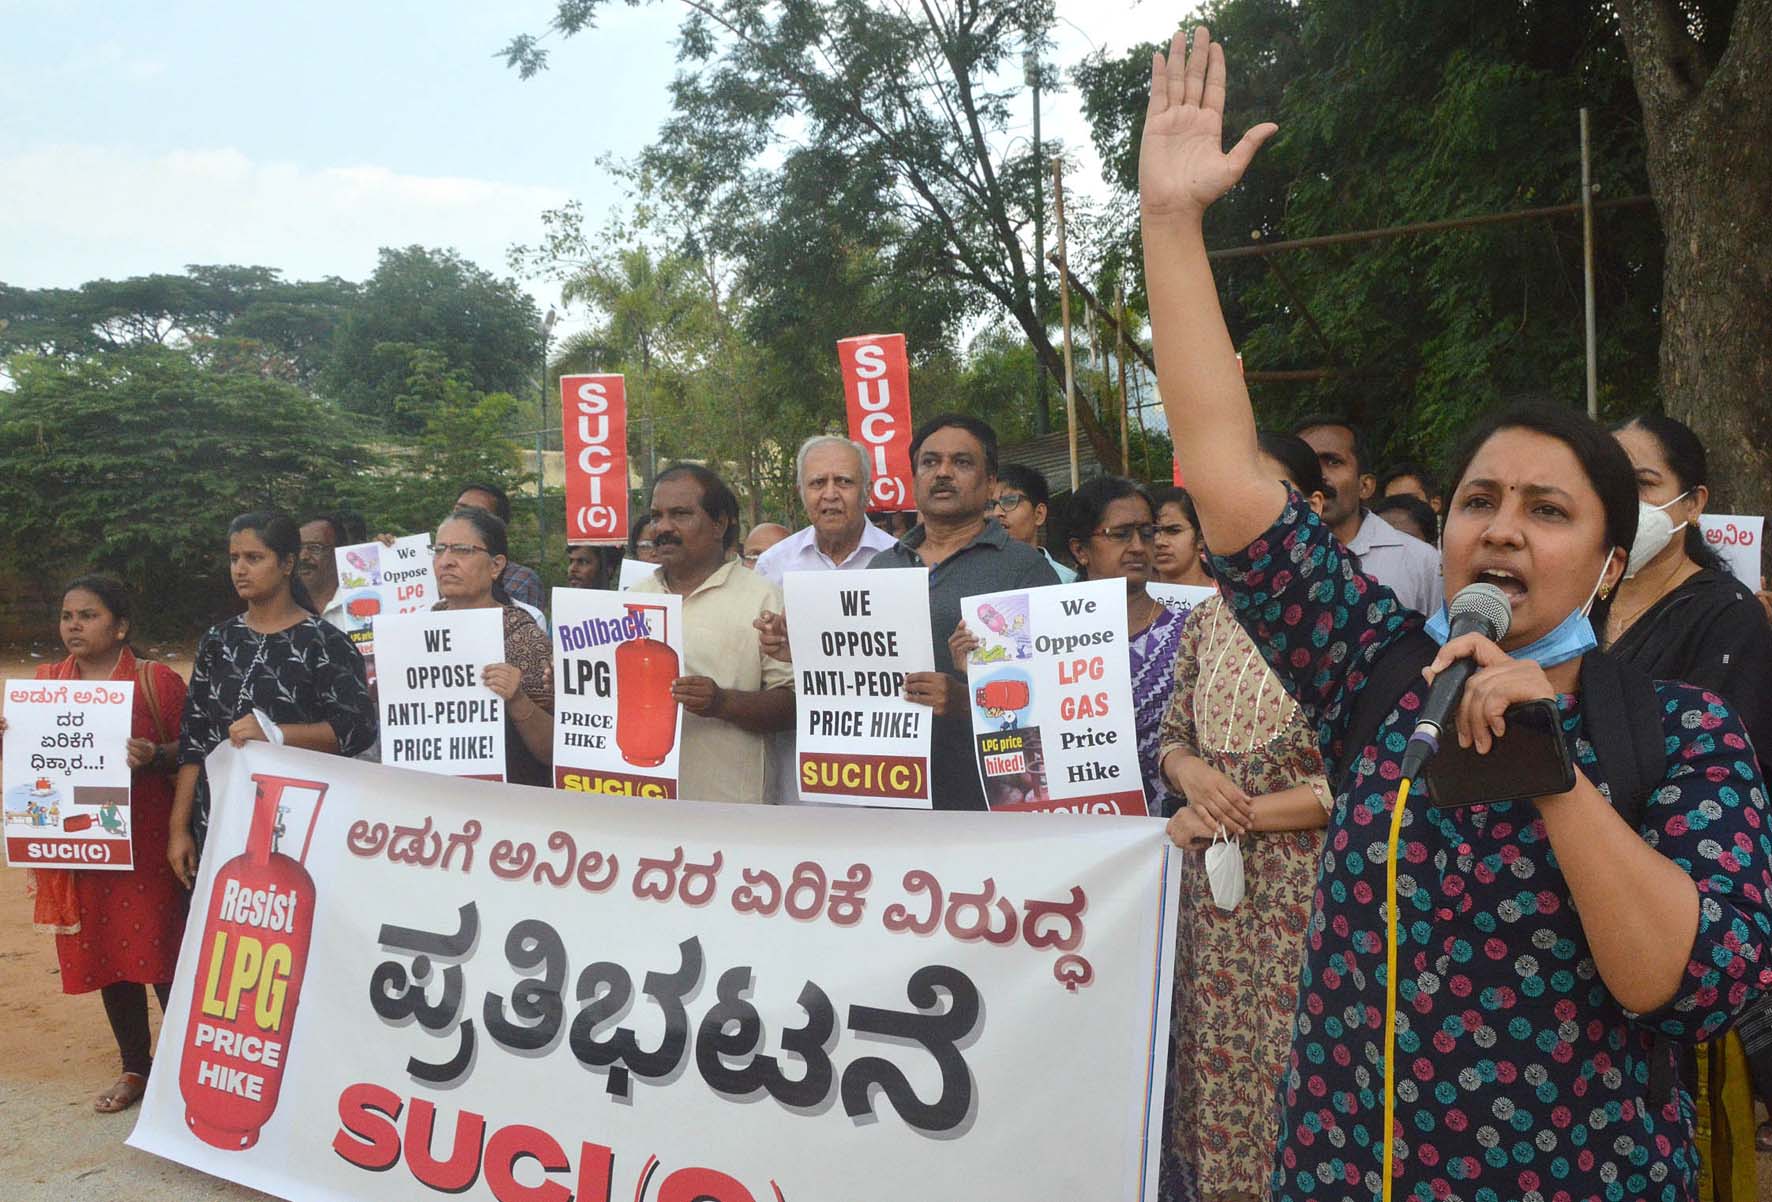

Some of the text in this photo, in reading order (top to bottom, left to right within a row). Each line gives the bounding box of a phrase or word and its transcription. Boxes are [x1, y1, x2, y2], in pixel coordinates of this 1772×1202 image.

[1705, 523, 1755, 546] ಅನಿಲ
[397, 547, 416, 560] We
[383, 567, 428, 583] Oppose
[397, 584, 425, 602] LPG
[840, 590, 872, 617] WE
[1061, 599, 1097, 617] We
[424, 629, 452, 653] WE
[558, 610, 651, 653] Rollback
[821, 631, 899, 657] OPPOSE
[1035, 629, 1114, 655] Oppose
[406, 664, 476, 690] OPPOSE
[562, 658, 612, 698] LPG
[803, 670, 908, 697] ANTI-PEOP
[1058, 656, 1105, 686] LPG
[10, 686, 126, 705] ಅಡುಗೆ ಅನಿಲ
[1060, 691, 1110, 721] GAS
[56, 711, 85, 727] ದರ
[387, 699, 499, 726] ANTI-PEOPLE
[560, 711, 613, 730] PRICE
[809, 710, 920, 739] PRICE HIKE!
[41, 732, 95, 749] ಏರಿಕೆಗೆ
[393, 735, 494, 762] PRICE HIKE!
[564, 732, 607, 750] HIKE
[982, 735, 1023, 753] LPG price
[1061, 727, 1118, 750] Price
[802, 761, 922, 793] SUCI(C)
[986, 755, 1025, 775] hiked!
[1066, 761, 1120, 784] Hike
[28, 843, 111, 862] SUCI(C)
[219, 879, 297, 934] Resist
[346, 816, 1094, 993] ಅಡುಗೆ ಅನಿಲ ದರ ಏರಿಕೆ ವಿರುದ್ಧ
[202, 930, 293, 1033] LPG
[369, 900, 984, 1139] ಪ್ರತಿಭಟನೆ
[194, 1023, 282, 1069] PRICE
[197, 1060, 265, 1103] HIKE
